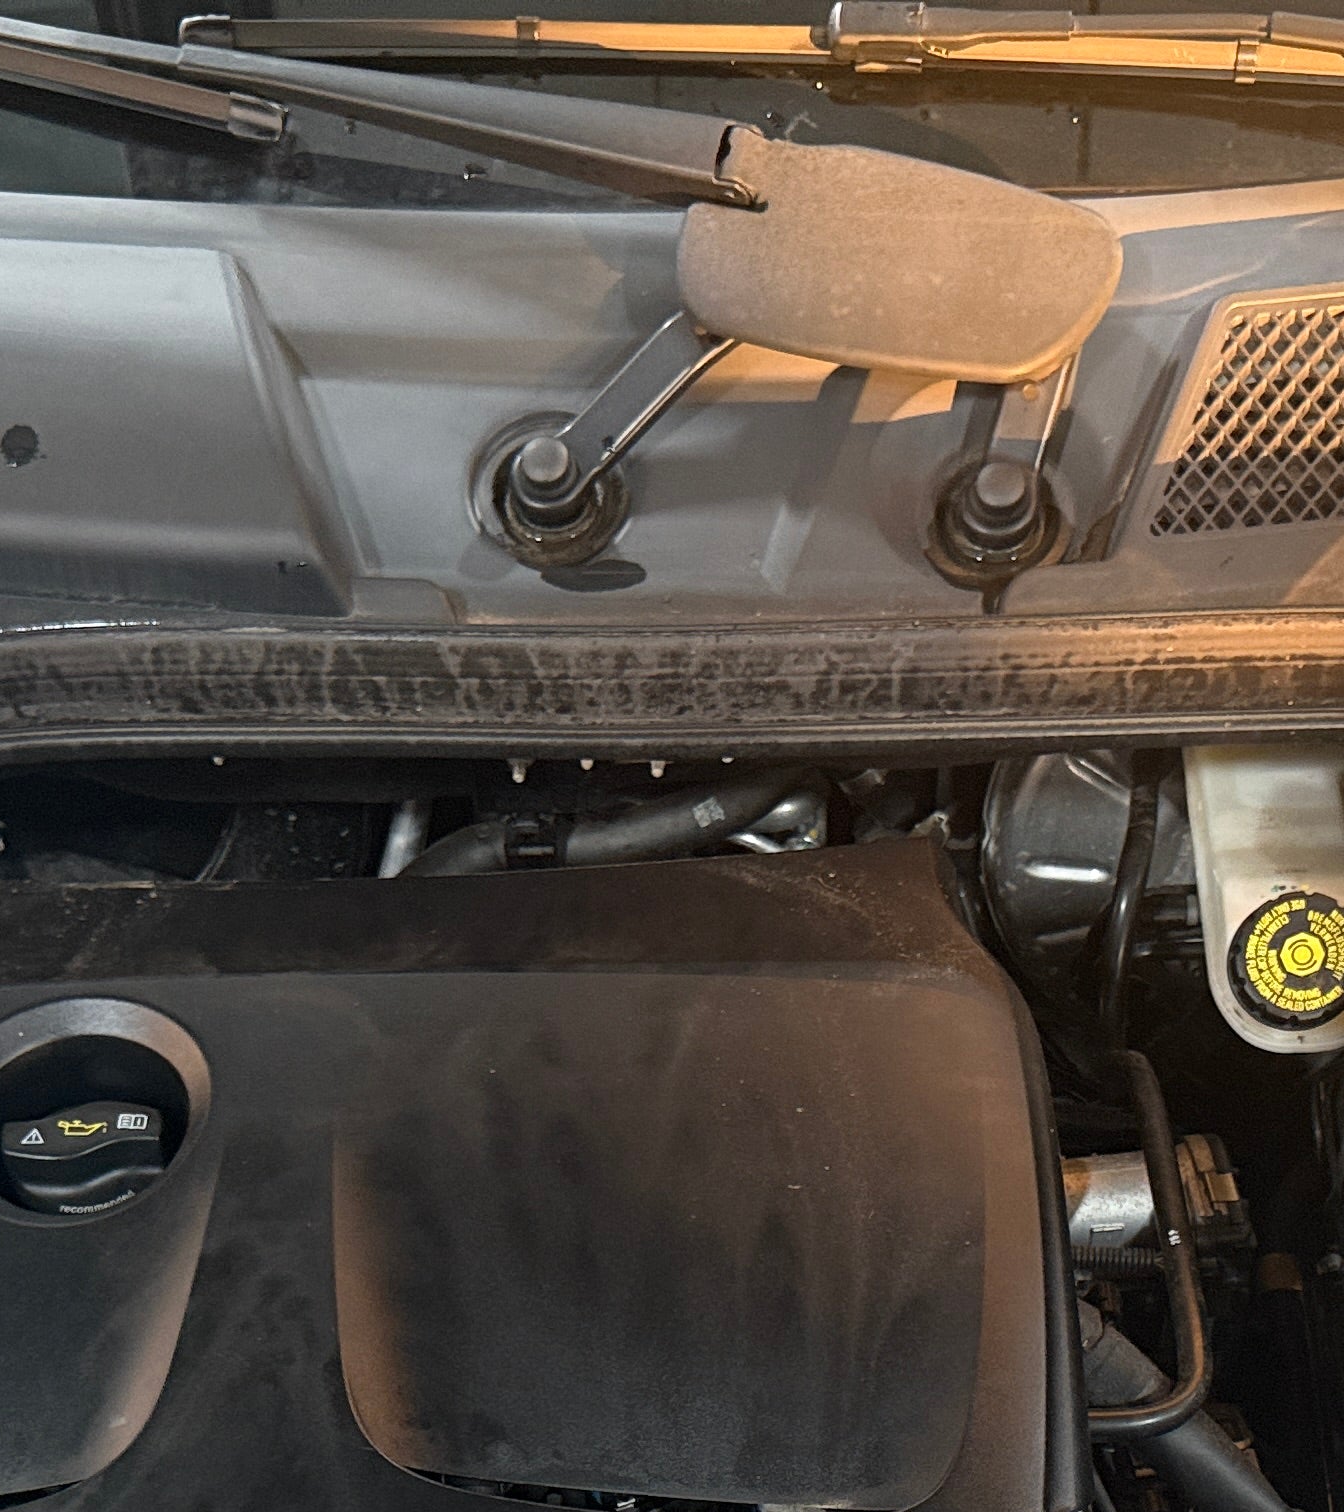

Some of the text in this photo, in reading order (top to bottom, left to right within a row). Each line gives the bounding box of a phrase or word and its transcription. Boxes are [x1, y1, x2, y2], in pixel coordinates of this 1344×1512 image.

[1310, 922, 1338, 970] VERWENDEN
[1305, 986, 1344, 1011] CONTAINER
[59, 1190, 136, 1214] recommended
